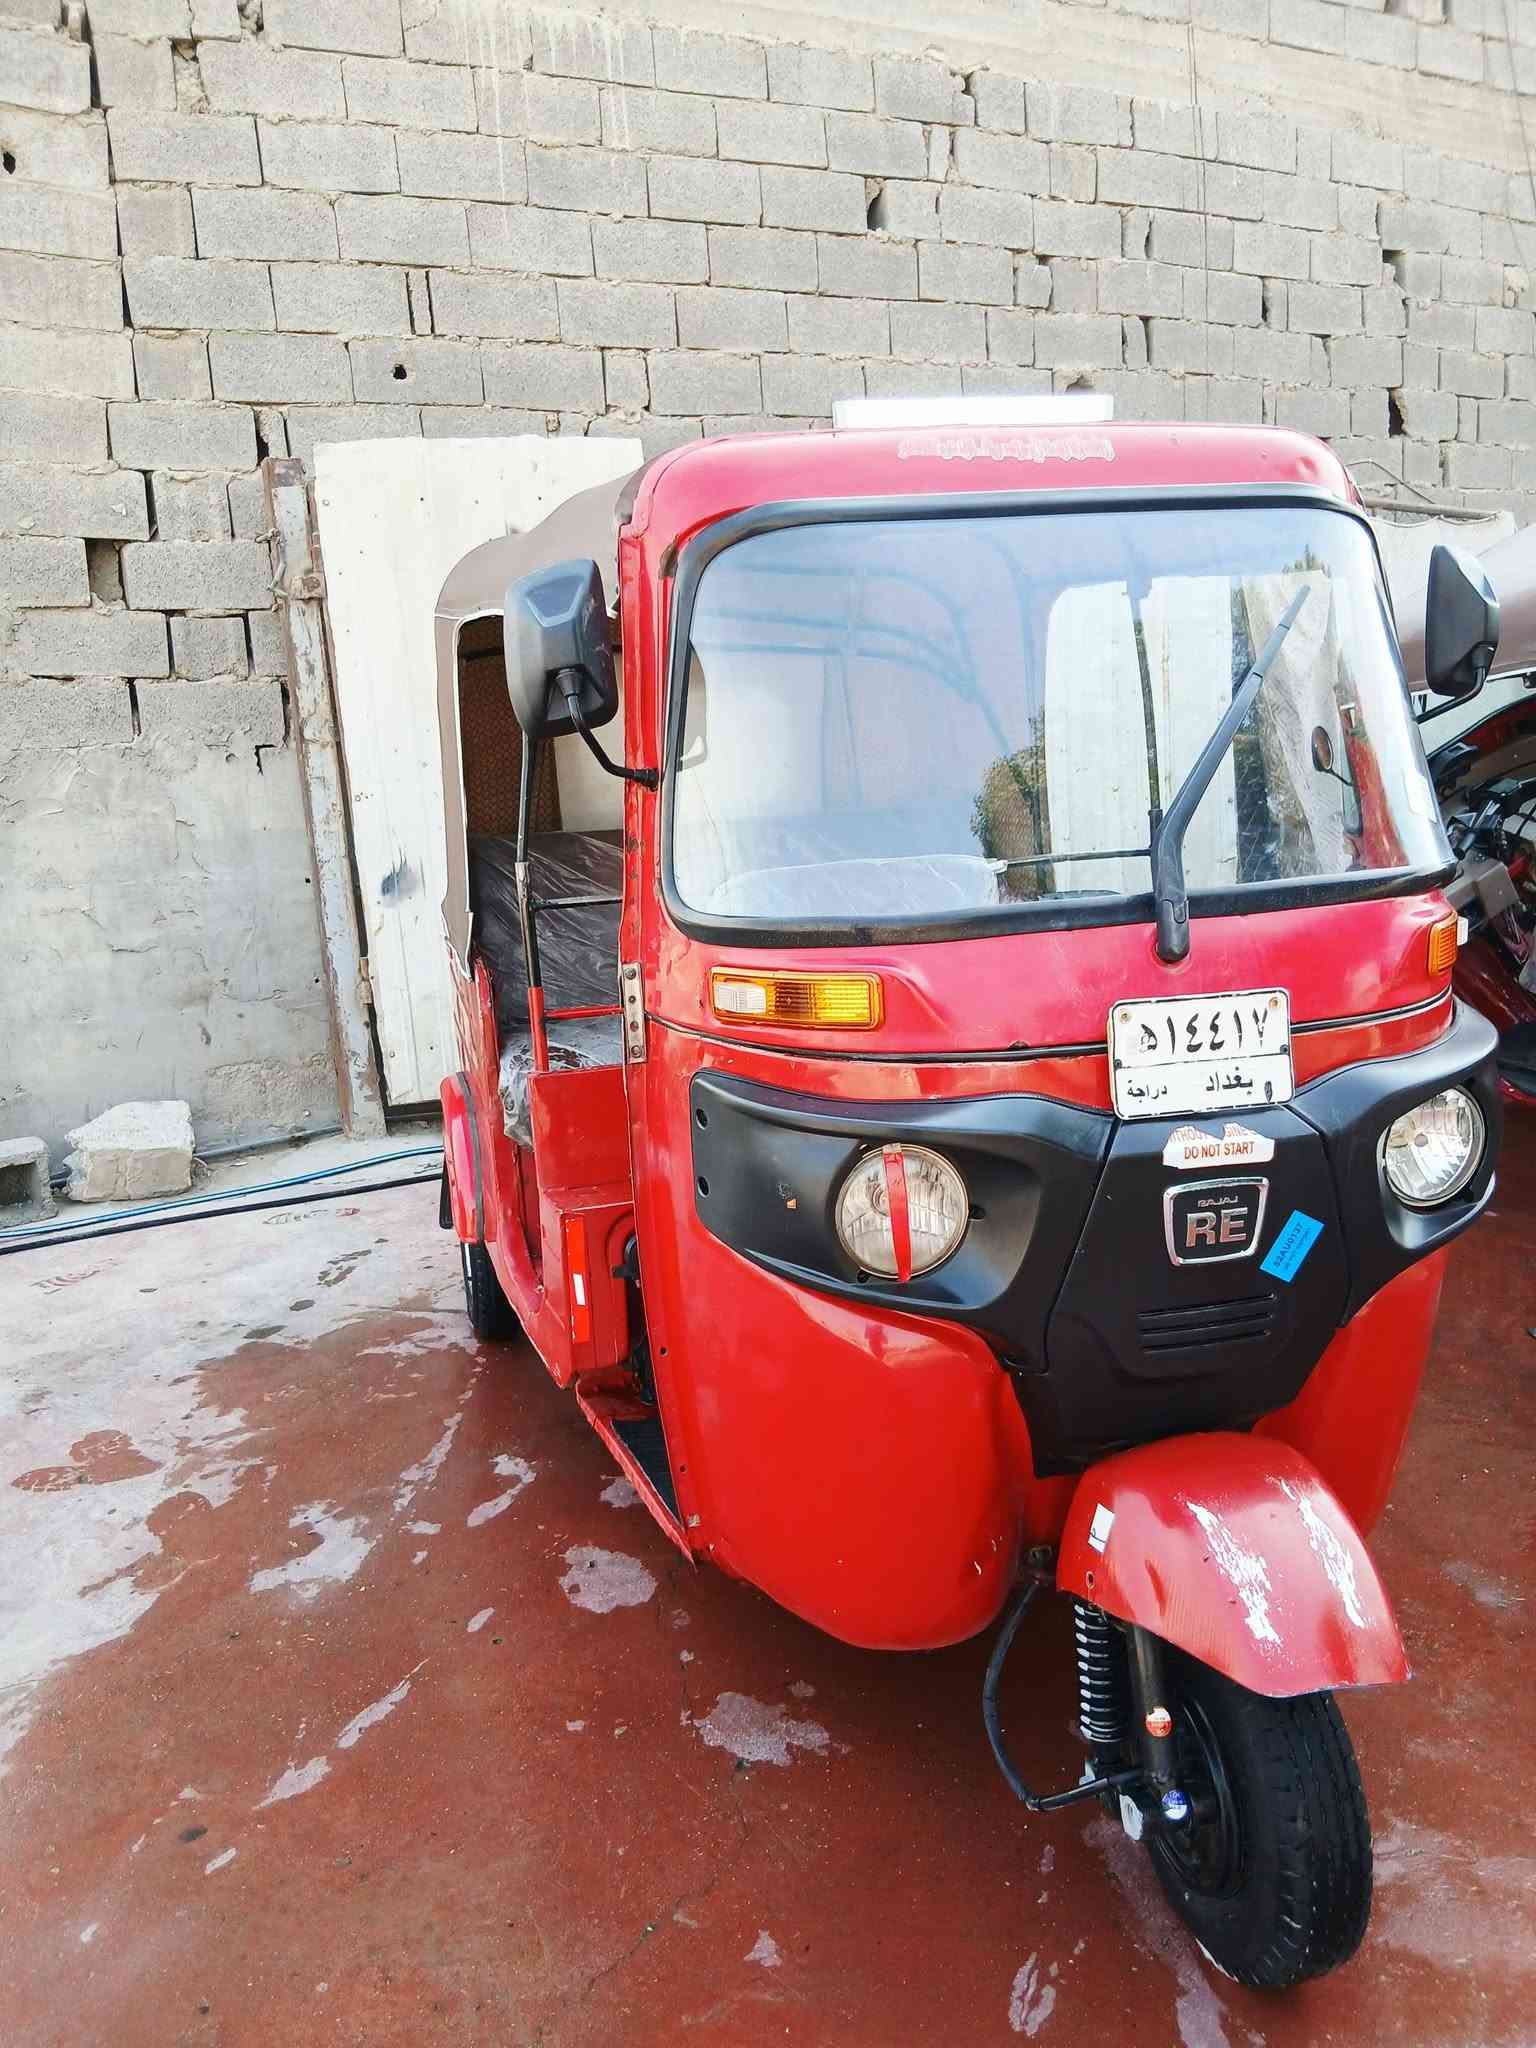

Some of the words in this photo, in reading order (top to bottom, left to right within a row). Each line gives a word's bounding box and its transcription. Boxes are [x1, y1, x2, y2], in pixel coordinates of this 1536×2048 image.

[1126, 1079, 1168, 1103] دراجة
[1205, 1066, 1254, 1096] بغداد
[1183, 1145, 1198, 1160] DO
[1201, 1143, 1221, 1158] NOT
[1223, 1140, 1255, 1156] START
[1197, 1195, 1239, 1208] BAJAJ
[1185, 1207, 1249, 1248] RE
